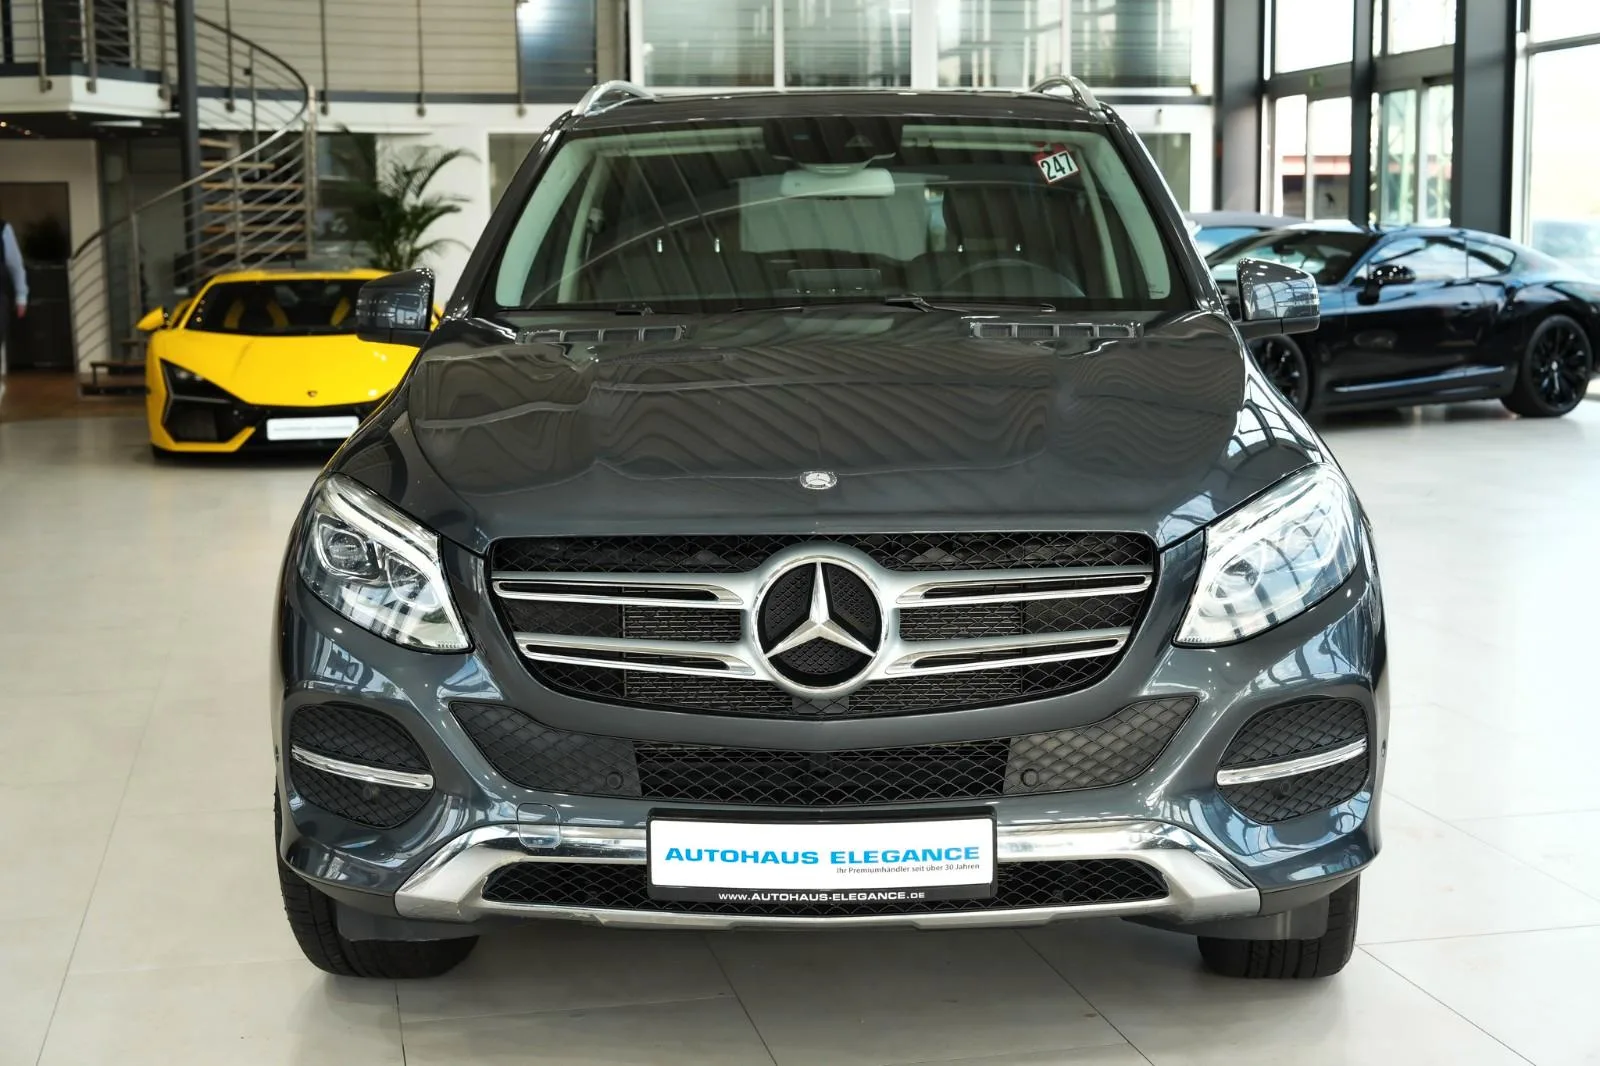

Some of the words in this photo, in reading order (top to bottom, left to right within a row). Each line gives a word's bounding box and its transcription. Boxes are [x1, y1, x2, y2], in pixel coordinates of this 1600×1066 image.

[1040, 152, 1073, 180] 247
[665, 847, 819, 864] AUTOHAUS
[830, 847, 980, 864] ELEGANCE
[911, 864, 925, 873] seit
[926, 863, 943, 872] über
[944, 863, 954, 871] 30
[955, 862, 980, 870] Jahren
